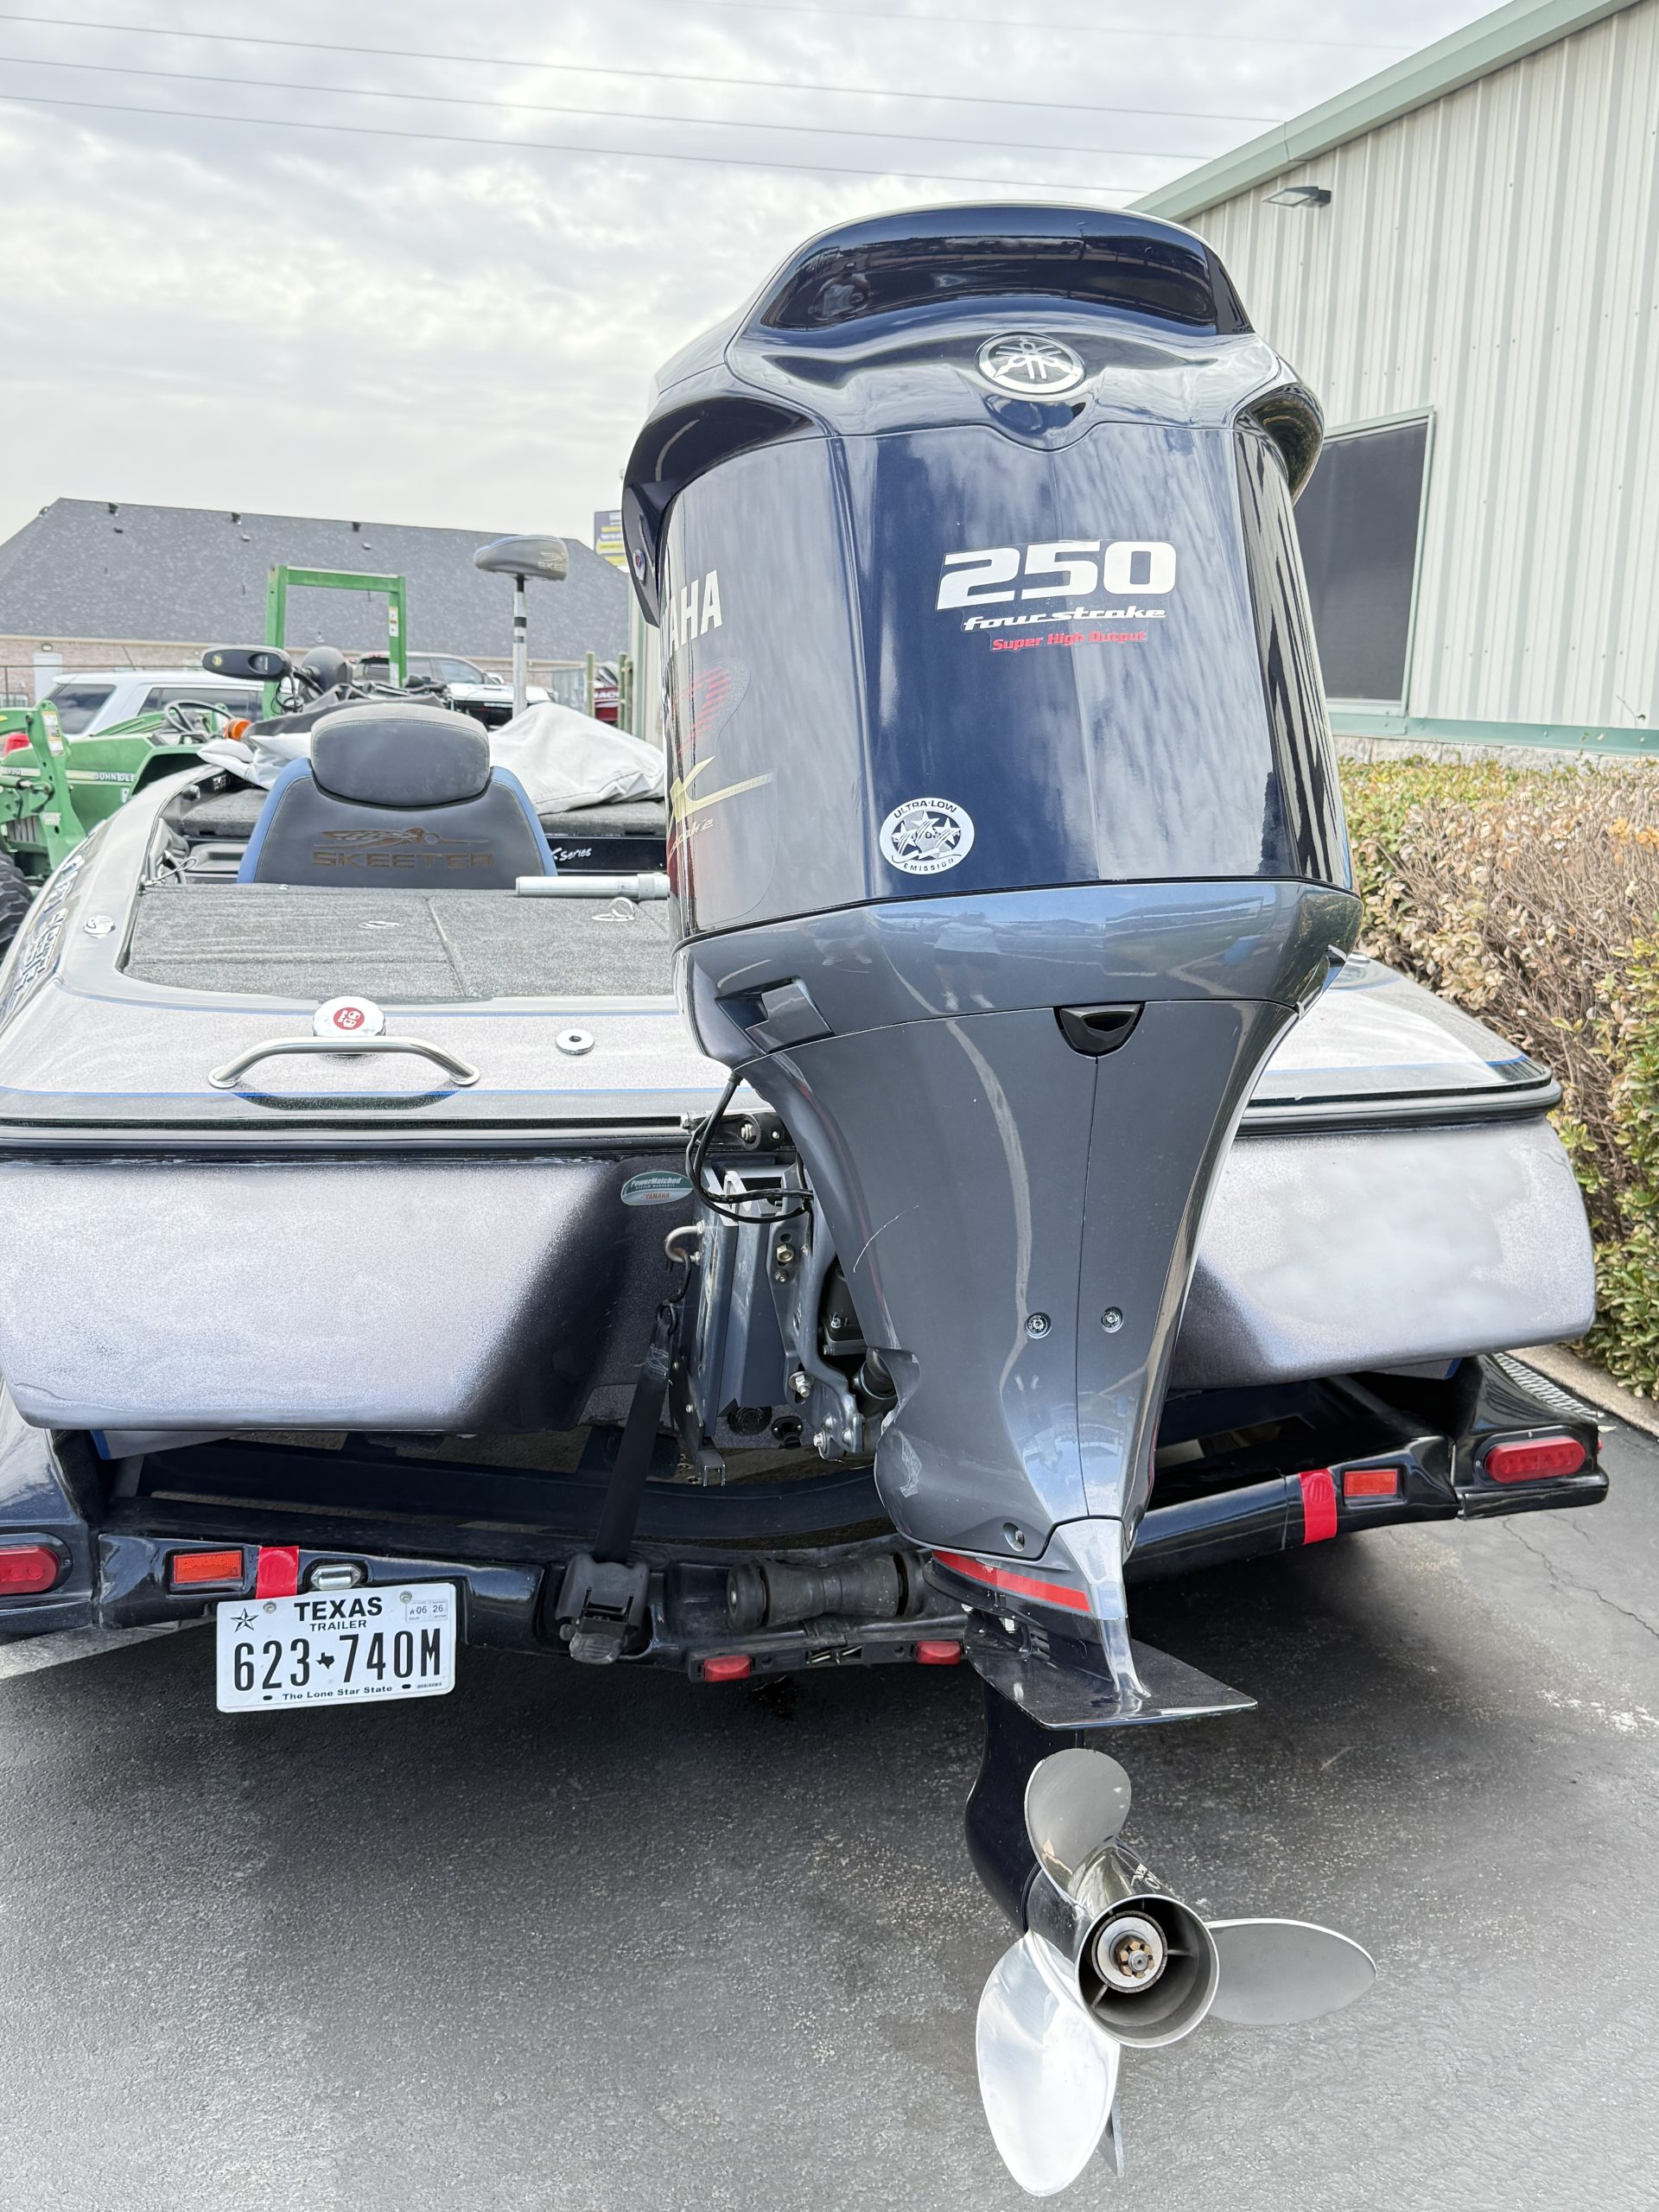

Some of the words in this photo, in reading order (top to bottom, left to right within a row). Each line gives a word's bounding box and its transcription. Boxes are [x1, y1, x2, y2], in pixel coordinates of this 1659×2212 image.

[937, 541, 1176, 610] 250
[992, 637, 1043, 651] Super
[1047, 632, 1084, 645] High
[1089, 631, 1147, 644] Output
[312, 851, 494, 870] SKEETER
[903, 858, 954, 872] EMISSION
[631, 1177, 682, 1188] PowerMatched
[294, 1597, 383, 1622] TEXAS
[416, 1605, 428, 1614] 06
[432, 1604, 444, 1613] 26
[309, 1619, 367, 1632] TRAILER
[283, 1693, 303, 1701] The
[307, 1690, 334, 1699] Lone
[363, 1685, 393, 1694] State
